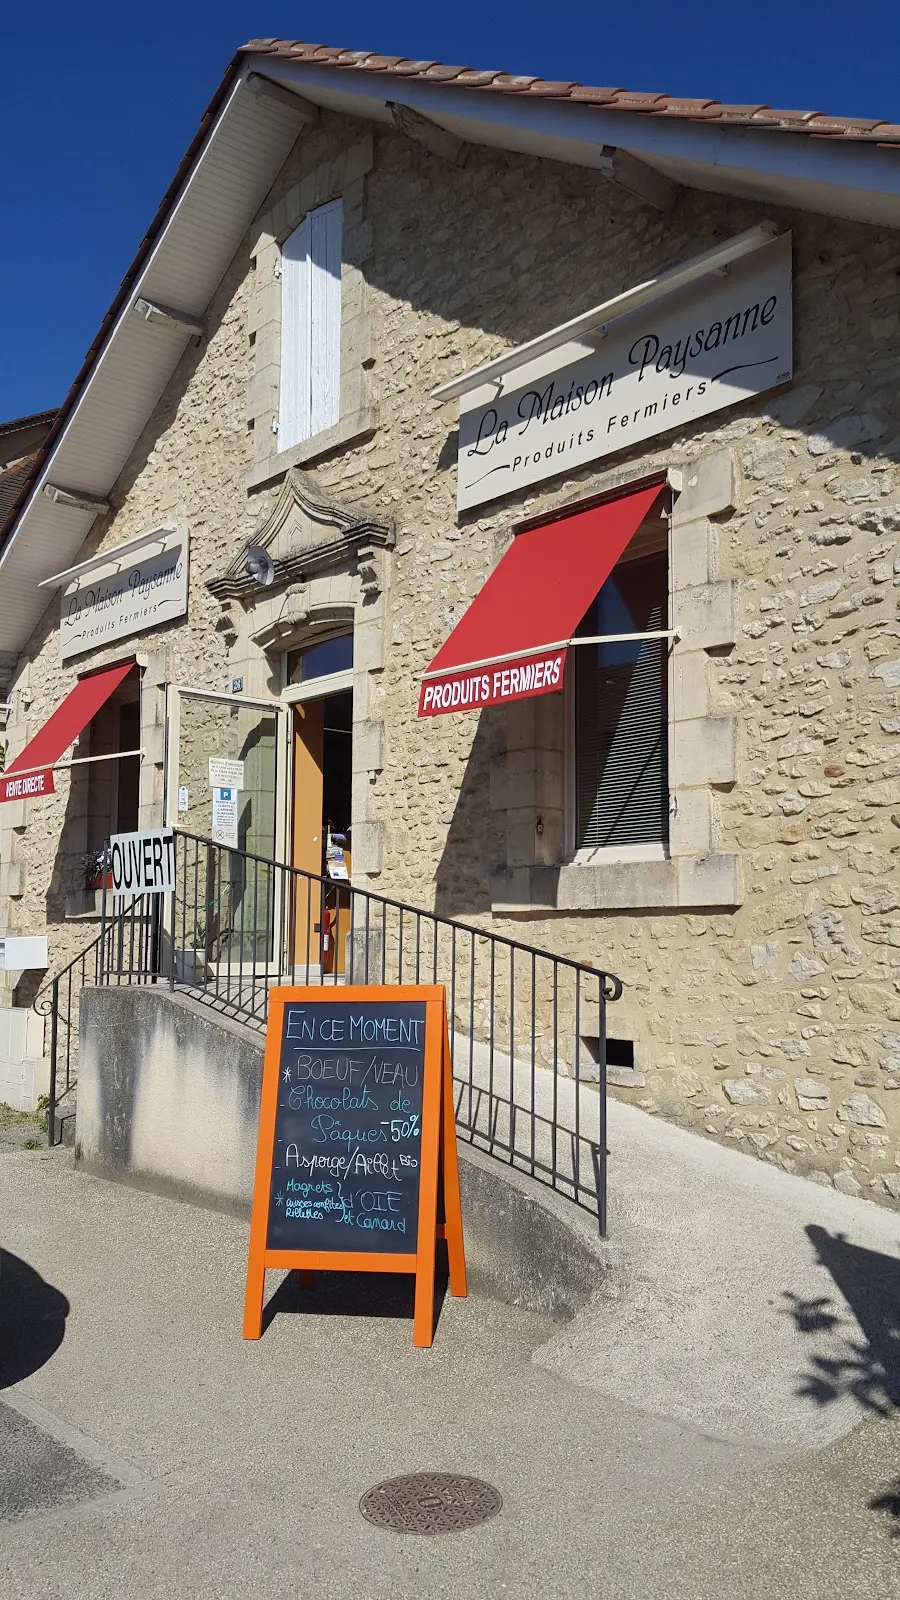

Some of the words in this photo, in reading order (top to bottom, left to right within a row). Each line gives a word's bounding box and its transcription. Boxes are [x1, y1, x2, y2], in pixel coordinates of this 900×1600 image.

[467, 409, 509, 457] La
[517, 371, 614, 436] Maison
[627, 295, 778, 382] Paysanne
[512, 427, 595, 471] Produits
[606, 381, 707, 433] Fermiers
[64, 597, 81, 626] La
[85, 587, 123, 617] Maison
[128, 563, 182, 600] Paysanne
[81, 623, 115, 640] Produits
[119, 604, 157, 625] Fermiers
[423, 675, 490, 710] PRODUITS
[493, 657, 561, 698] FERMIERS
[6, 779, 22, 797] VENTE
[23, 775, 45, 793] DIRECTE
[112, 836, 174, 889] OUVERT
[286, 1010, 315, 1041] EN
[319, 1019, 345, 1041] CE
[350, 1015, 425, 1044] MOMENT
[288, 1084, 379, 1111] Chocolats
[390, 1090, 411, 1114] de
[286, 1180, 333, 1198] Magrets
